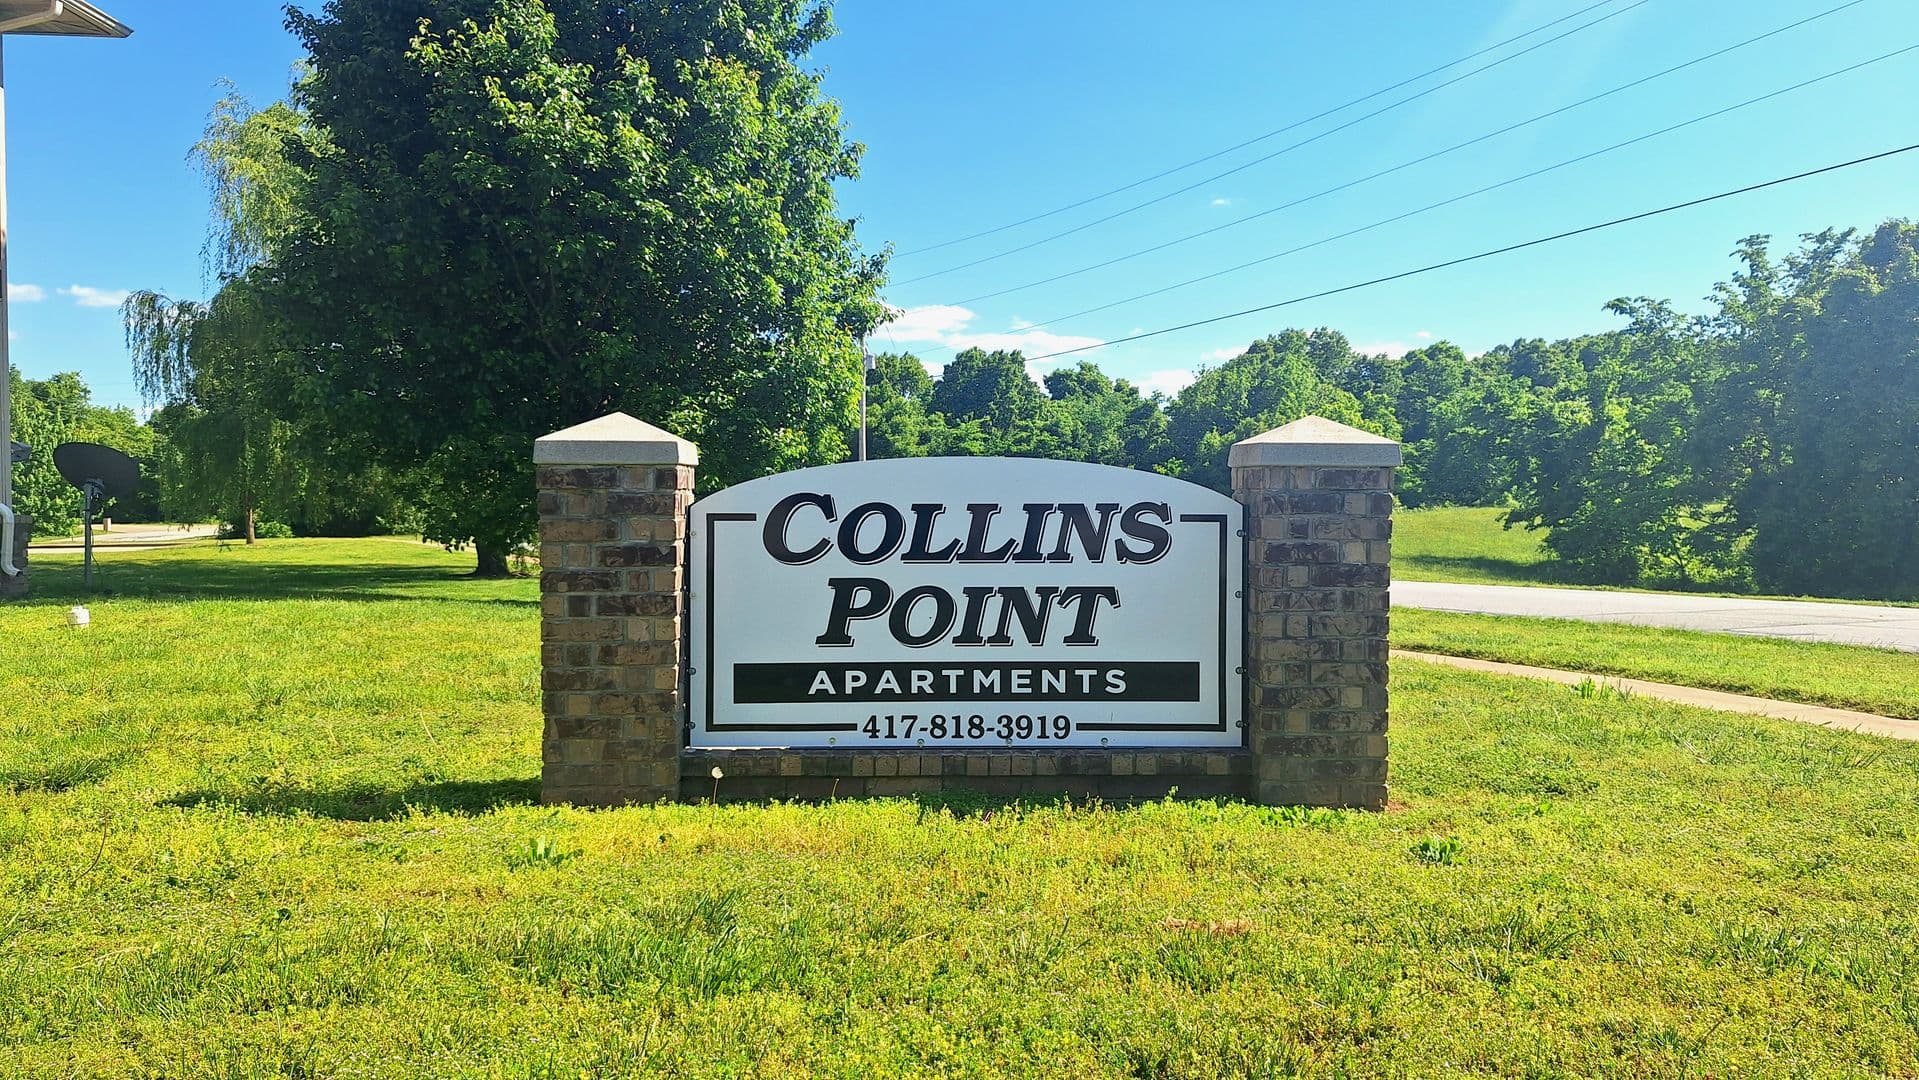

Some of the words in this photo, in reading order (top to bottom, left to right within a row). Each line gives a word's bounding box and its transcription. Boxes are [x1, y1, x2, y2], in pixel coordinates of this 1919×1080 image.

[762, 492, 1172, 565] COLLINS
[815, 577, 1120, 648] POINT
[808, 669, 1128, 695] APARTMENTS
[862, 715, 1072, 739] 417-818-3919
